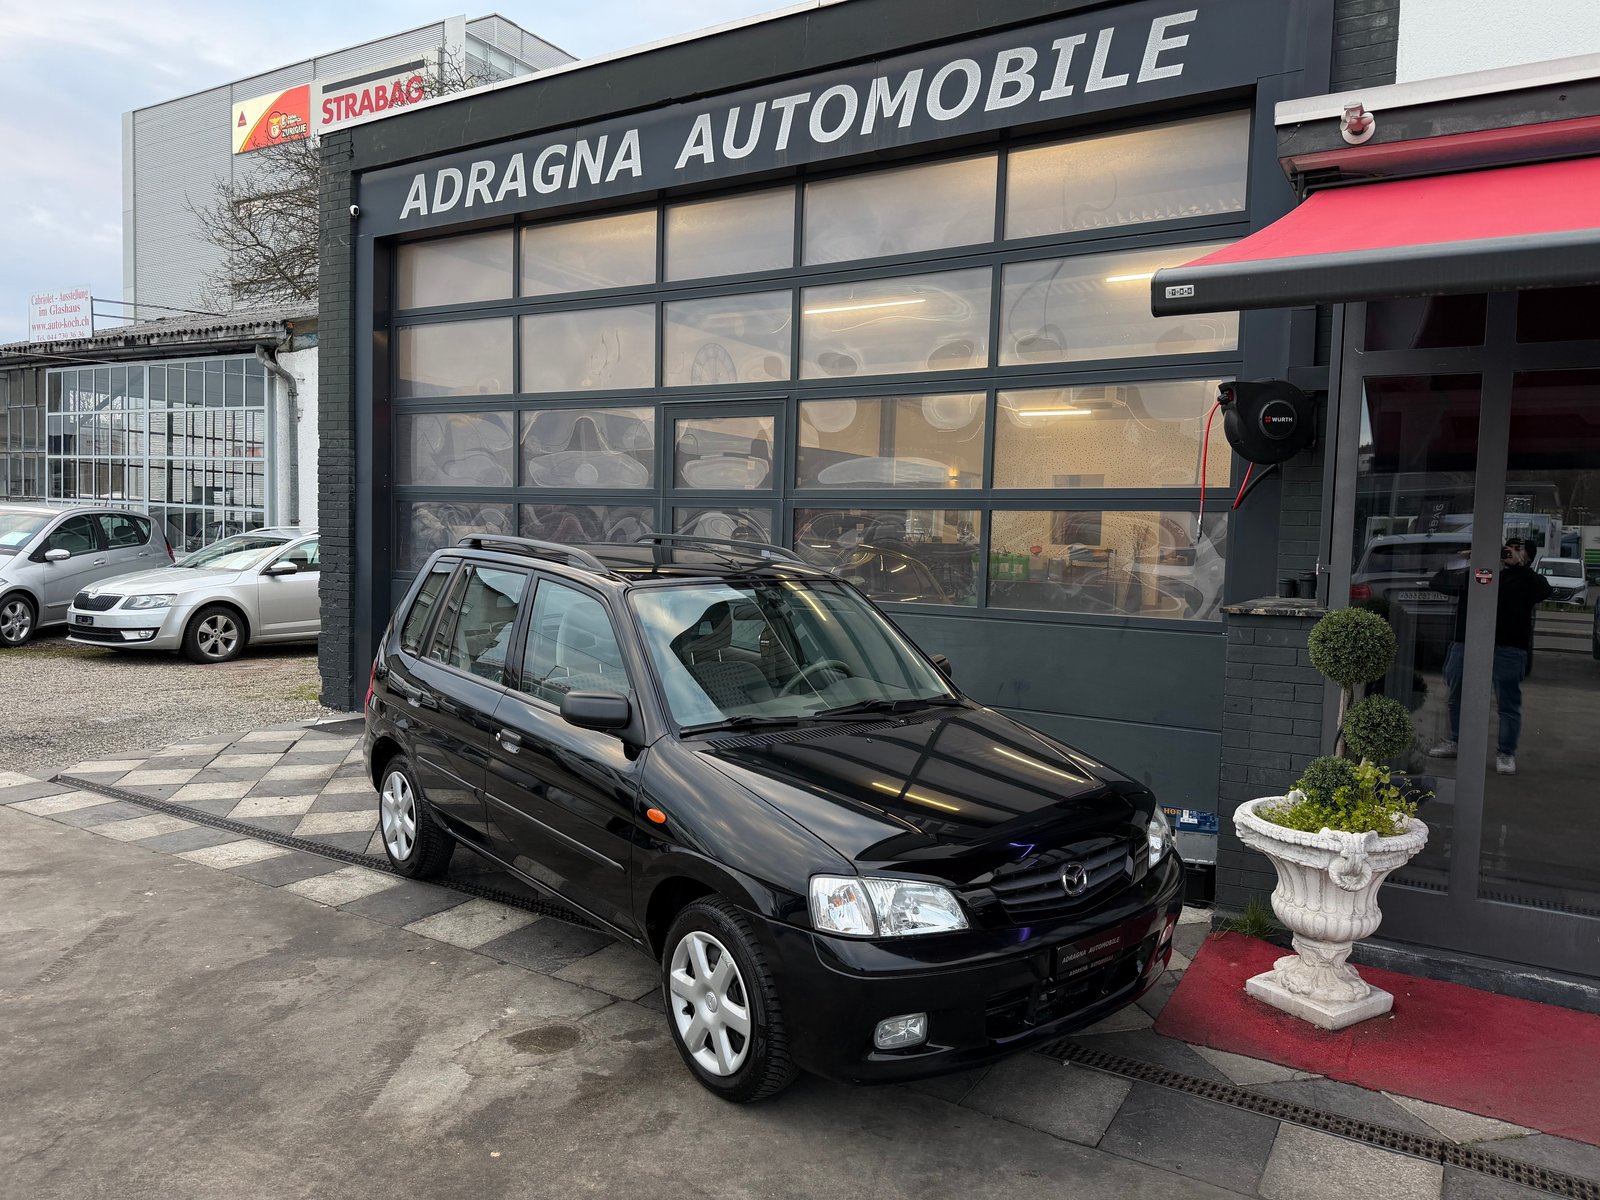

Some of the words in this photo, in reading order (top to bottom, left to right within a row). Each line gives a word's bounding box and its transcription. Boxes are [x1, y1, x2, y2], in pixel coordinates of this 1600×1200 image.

[321, 75, 425, 125] STRABAG
[399, 129, 643, 219] ADRAGNA
[674, 9, 1198, 170] AUTOMOBILE
[31, 293, 54, 306] Cabriolet
[59, 289, 89, 302] Ausstellung
[38, 306, 48, 317] im
[49, 303, 81, 316] Glashaus
[31, 316, 90, 331] www.auto-koch.ch
[1061, 949, 1087, 965] ADRAGNA
[1088, 936, 1121, 954] AUTOMOBILE
